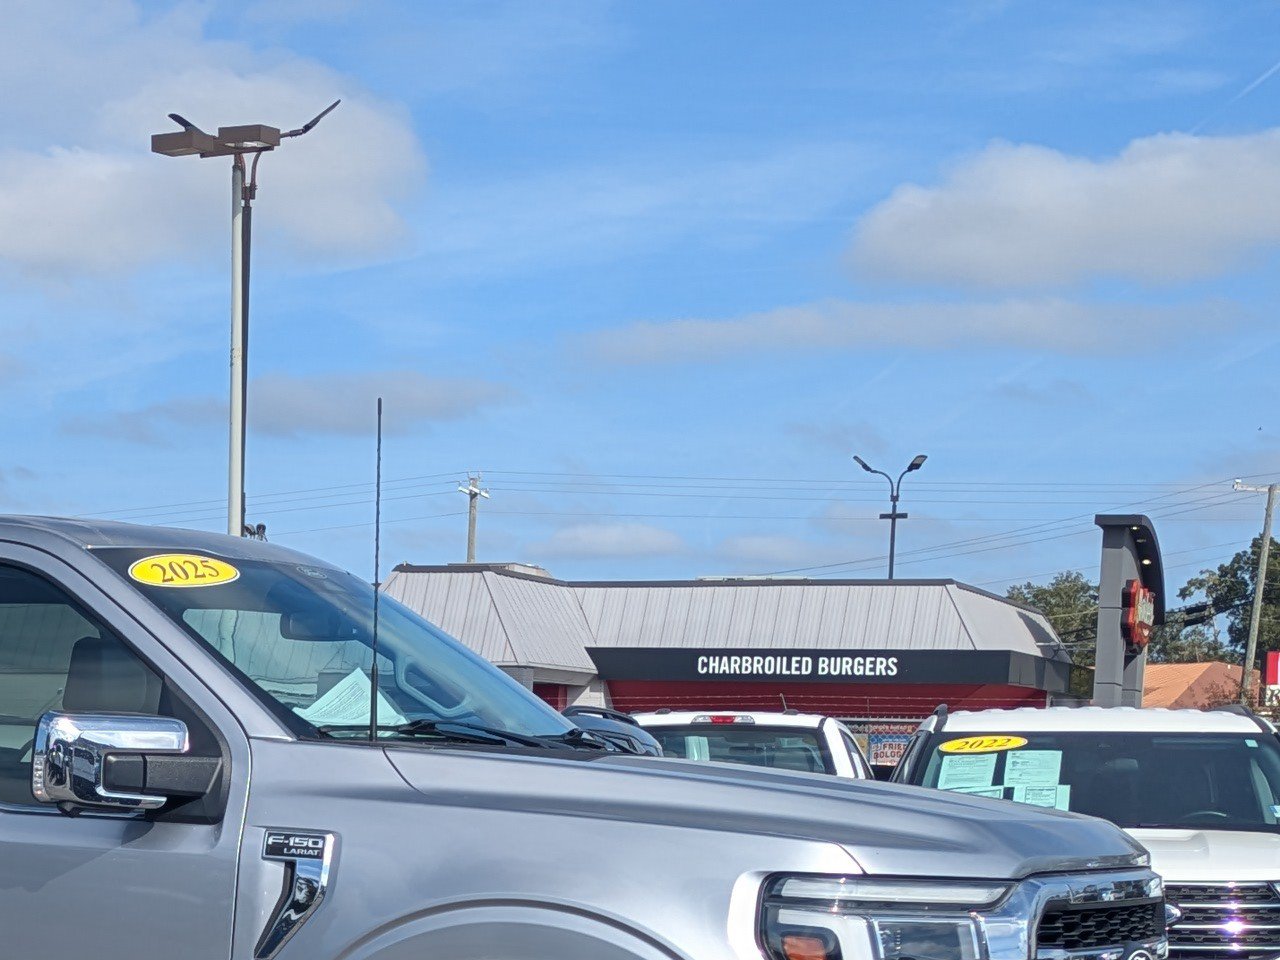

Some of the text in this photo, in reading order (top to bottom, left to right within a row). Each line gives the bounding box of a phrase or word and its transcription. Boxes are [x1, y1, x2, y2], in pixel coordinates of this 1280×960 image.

[151, 560, 219, 583] 2025
[697, 655, 898, 677] CHARBROILED BURGERS
[954, 738, 1012, 750] 2022
[267, 835, 323, 848] F-150
[283, 847, 320, 855] LARIAT
